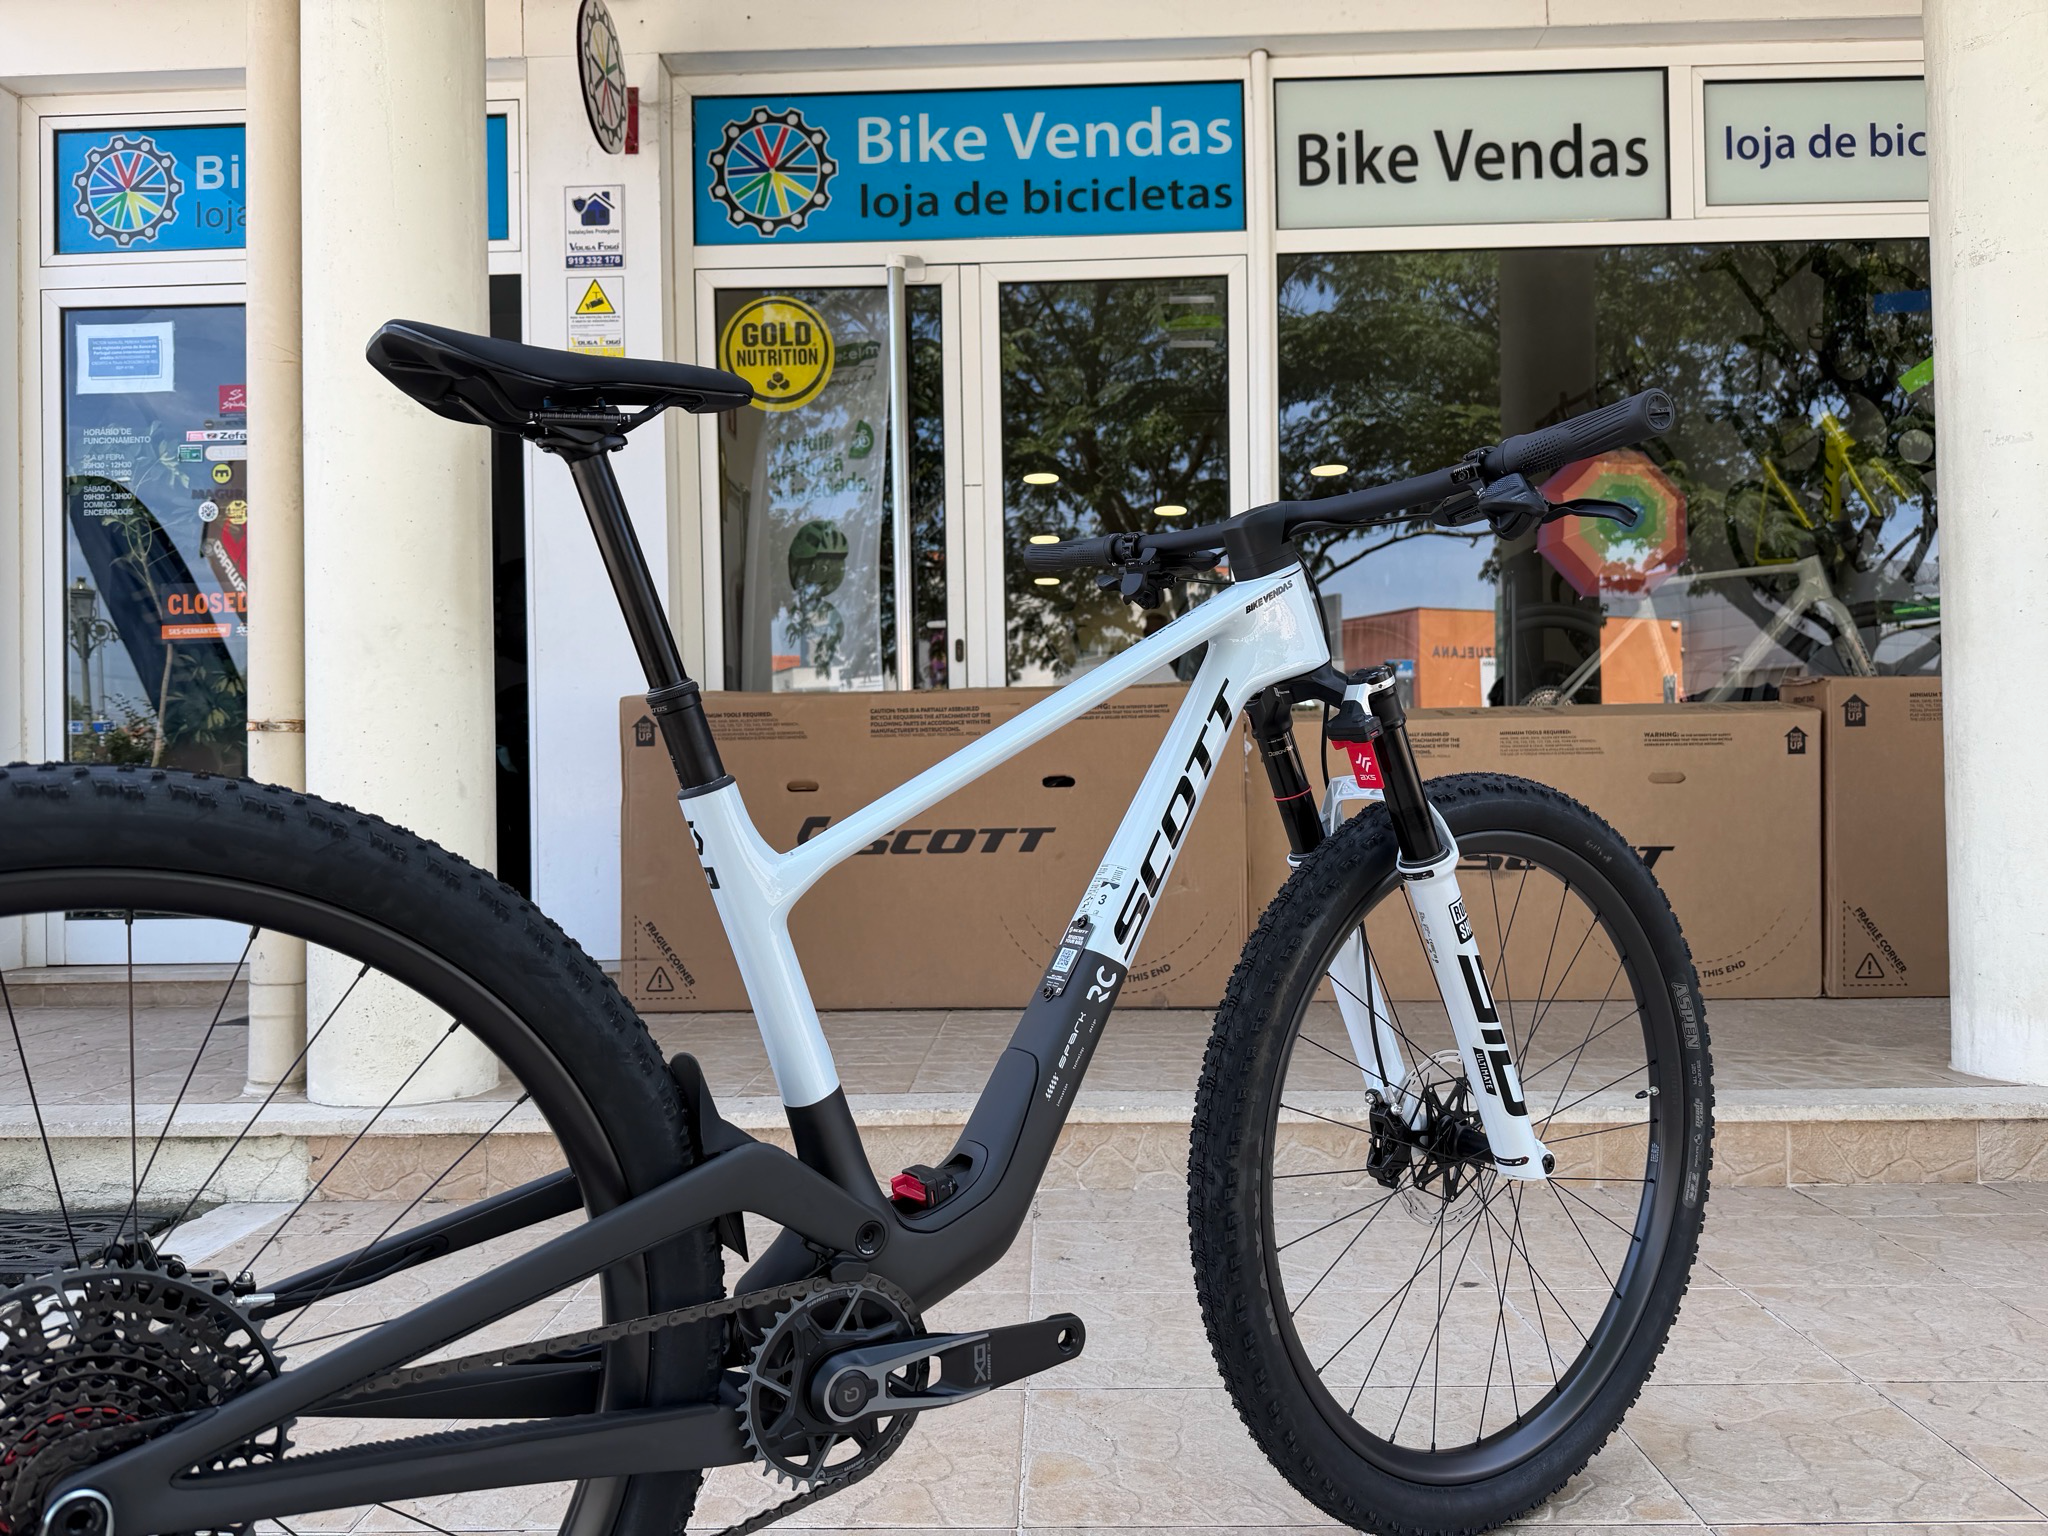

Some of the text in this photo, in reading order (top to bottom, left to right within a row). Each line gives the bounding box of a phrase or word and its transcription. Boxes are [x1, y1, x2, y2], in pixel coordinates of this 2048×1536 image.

[858, 106, 1232, 164] Bike Vendas
[1726, 126, 1794, 169] loja
[1808, 123, 1856, 159] de
[1298, 122, 1648, 187] Bike Vendas
[860, 176, 1232, 226] loja de bicicletas
[568, 256, 620, 264] 919 332 178
[742, 321, 811, 347] GOLD
[736, 348, 818, 367] NUTRITION
[83, 427, 119, 436] HORÁRIO
[83, 436, 151, 444] FUNCIONAMENTO
[84, 484, 111, 492] SÁBADO
[168, 592, 247, 615] CLOSED
[1246, 580, 1293, 614] BIKE VENDAS
[638, 733, 652, 742] UP
[1114, 678, 1233, 962] SCOTT
[854, 827, 1056, 855] SCOTT
[1098, 894, 1107, 905] 3
[645, 921, 695, 986] FRAGILE CORNER
[1855, 907, 1907, 973] FRAGILE CORNER
[1127, 964, 1171, 983] THIS END
[1702, 960, 1746, 978] THIS END
[1086, 965, 1116, 1003] RC
[1671, 982, 1700, 1050] ASPEN
[1476, 1054, 1494, 1090] ULTIMATE
